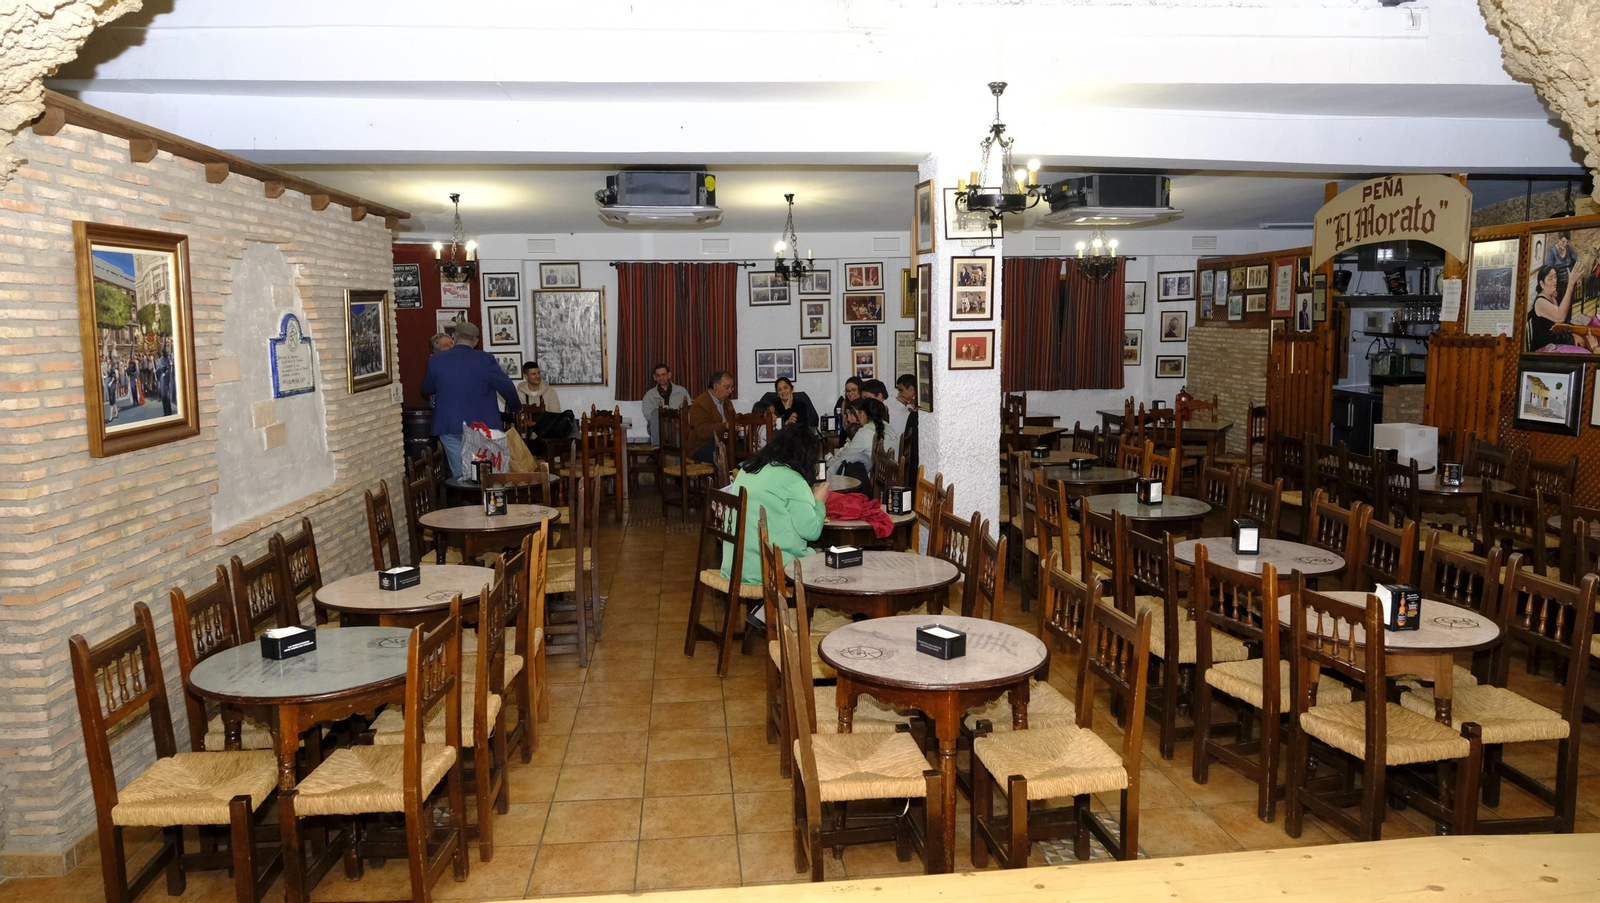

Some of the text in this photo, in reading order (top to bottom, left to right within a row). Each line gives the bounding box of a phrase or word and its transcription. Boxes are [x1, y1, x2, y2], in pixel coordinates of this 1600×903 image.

[1362, 176, 1404, 203] PEÑA
[1325, 195, 1449, 251] "El Morato"
